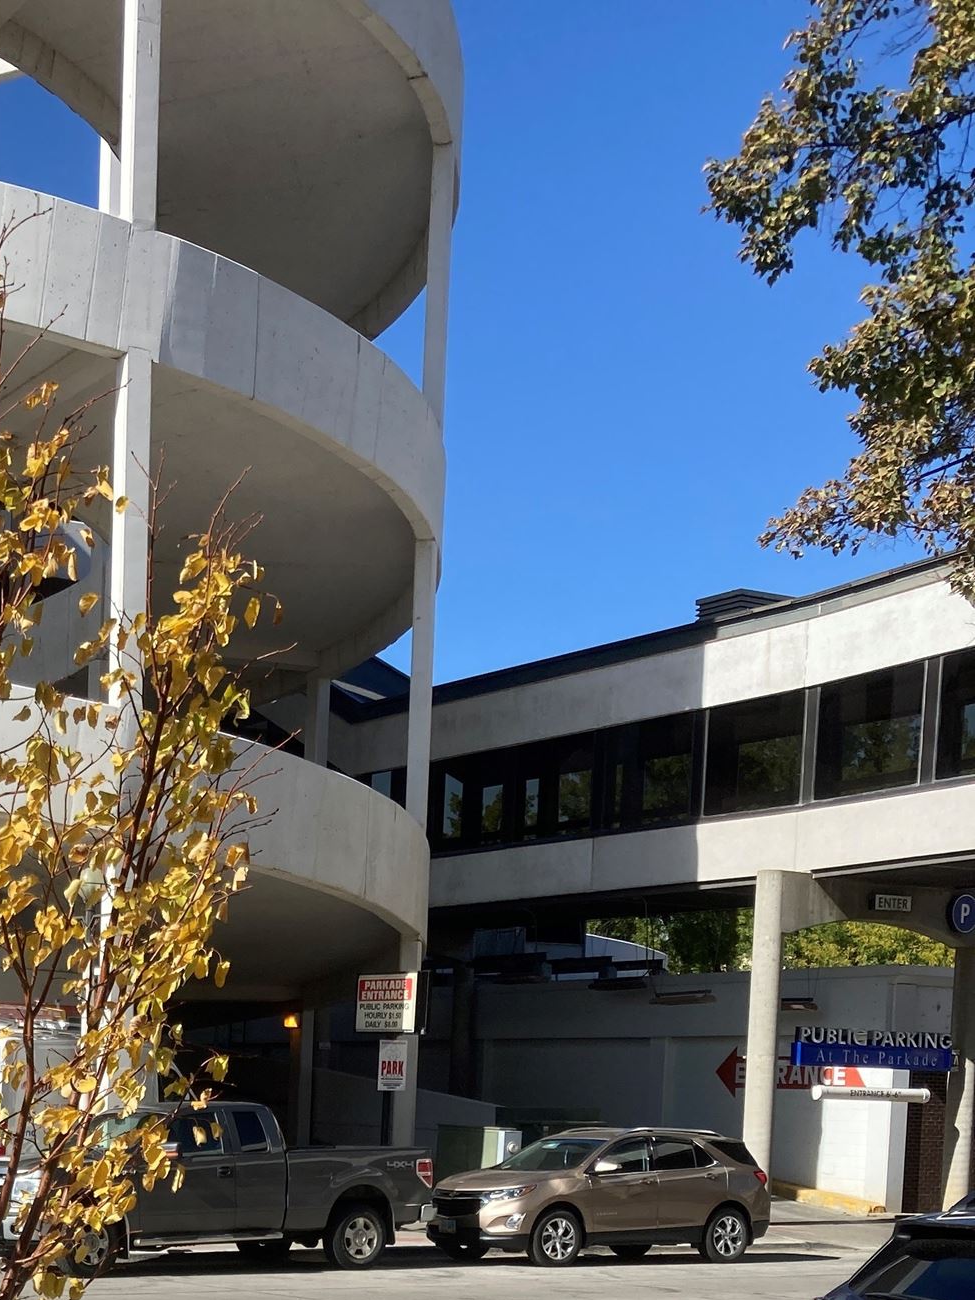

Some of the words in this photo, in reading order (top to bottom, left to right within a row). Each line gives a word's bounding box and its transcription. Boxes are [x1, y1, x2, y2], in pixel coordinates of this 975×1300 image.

[878, 897, 908, 909] ENTER
[960, 903, 971, 924] P
[364, 980, 407, 990] PARKADE
[361, 990, 409, 1000] ENTRANCE
[365, 1020, 381, 1028] DAILY
[800, 1026, 867, 1046] PUBLIC
[872, 1030, 953, 1050] PARKING
[816, 1049, 833, 1063] At
[843, 1049, 869, 1064] The
[878, 1051, 938, 1067] Parkade
[381, 1060, 404, 1077] PARK
[735, 1062, 846, 1086] ERANCE
[849, 1089, 885, 1098] ENTRANCE
